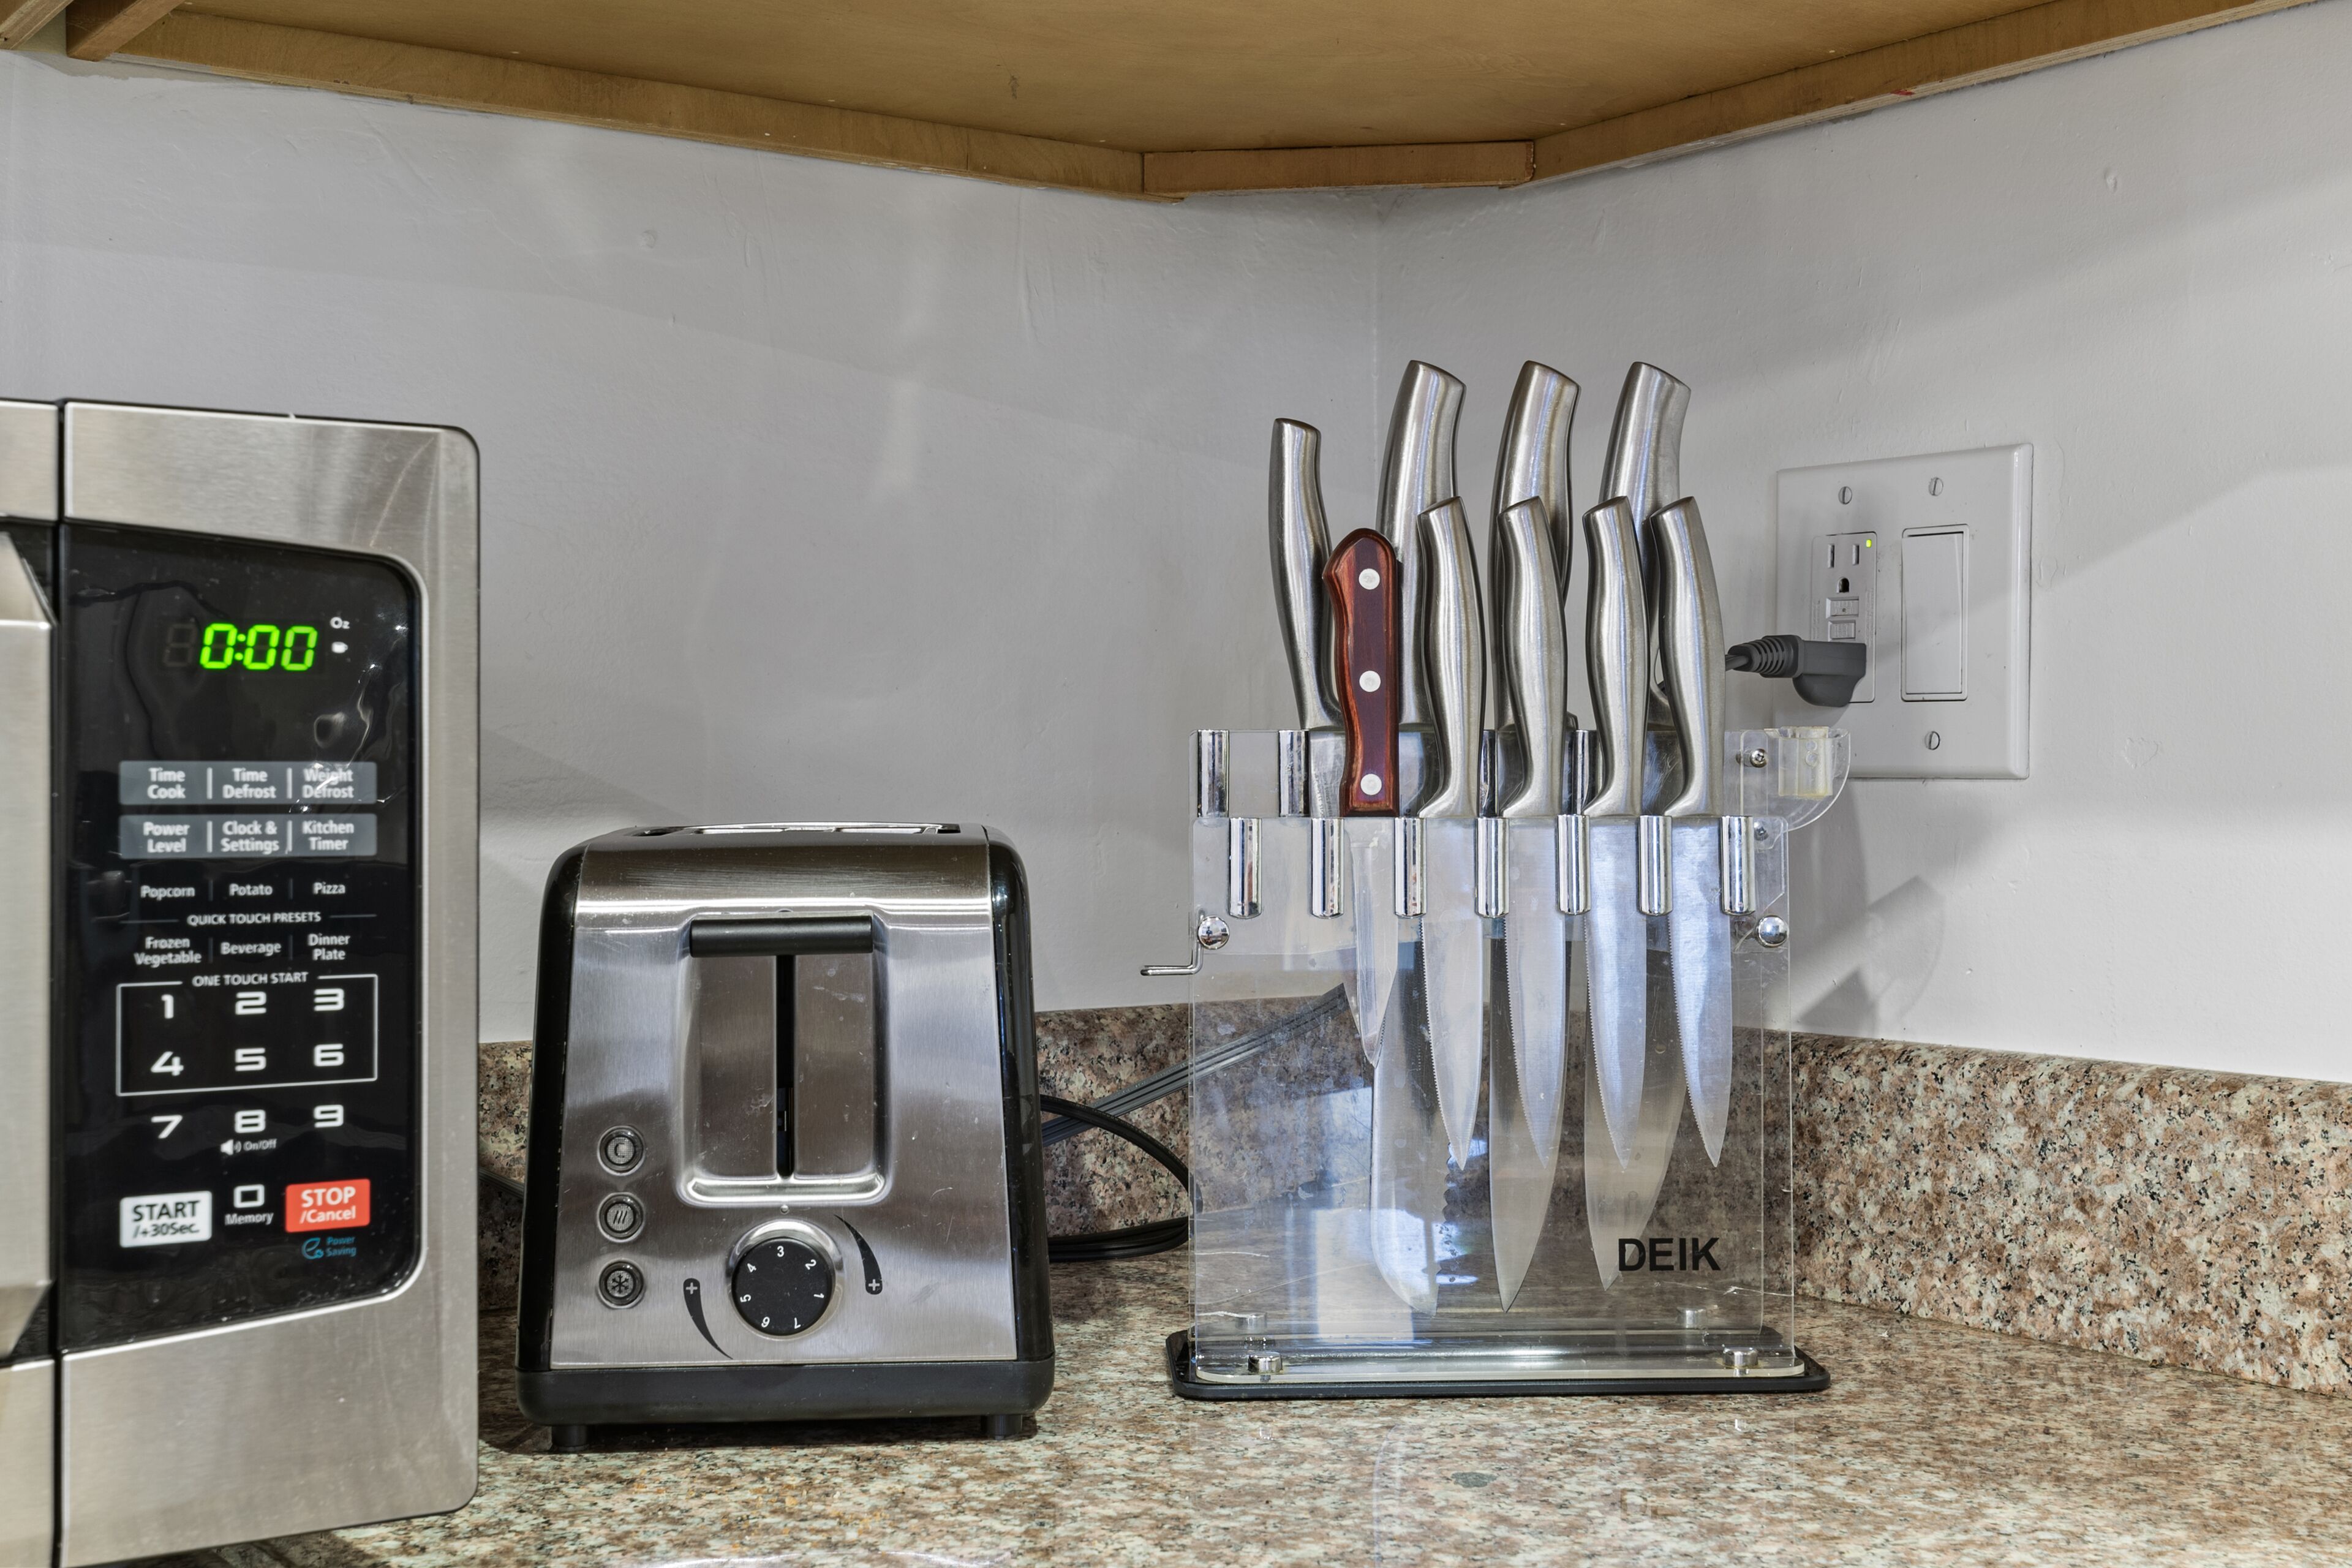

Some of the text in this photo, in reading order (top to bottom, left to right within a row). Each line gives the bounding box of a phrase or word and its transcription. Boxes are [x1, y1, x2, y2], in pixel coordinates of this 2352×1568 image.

[200, 623, 318, 671] 0:00
[149, 767, 186, 782] Time
[232, 767, 268, 782] Time
[304, 768, 353, 785] Weight
[147, 784, 186, 799] Cook
[223, 784, 276, 798] Defrost
[303, 785, 353, 798] Defrost
[143, 821, 189, 835] Power
[222, 821, 277, 835] Clock &
[303, 820, 353, 834] Kitchen
[147, 839, 186, 853] Level
[221, 838, 279, 854] Settings
[309, 837, 349, 850] Timer
[140, 885, 195, 900] Popcorn
[229, 883, 273, 895] Potato
[313, 882, 345, 894] Pizza
[187, 911, 322, 926] QUICK TOUCH PRESETS
[145, 937, 190, 949] Frozen
[308, 933, 350, 946] Dinner
[221, 941, 281, 956] Beverage
[313, 948, 345, 960] Plate
[134, 951, 202, 968] Vegetable
[192, 971, 308, 987] ONE TOUCH START
[161, 994, 174, 1019] 1
[235, 991, 266, 1015] 2
[314, 988, 344, 1011] 3
[235, 1047, 266, 1071] 5
[314, 1044, 344, 1067] 6
[151, 1051, 184, 1076] 4
[235, 1109, 266, 1133] 8
[314, 1104, 344, 1128] 9
[151, 1115, 183, 1139] 7
[244, 1139, 277, 1152] On/Off
[301, 1186, 356, 1208] STOP
[133, 1200, 201, 1222] START
[300, 1206, 356, 1224] /Cancel
[225, 1212, 274, 1226] Memory
[326, 1237, 355, 1246] Power
[326, 1246, 356, 1258] Saving
[777, 1246, 784, 1257] 3
[1618, 1238, 1721, 1271] DEIK
[747, 1263, 756, 1272] 4
[805, 1259, 816, 1270] 2
